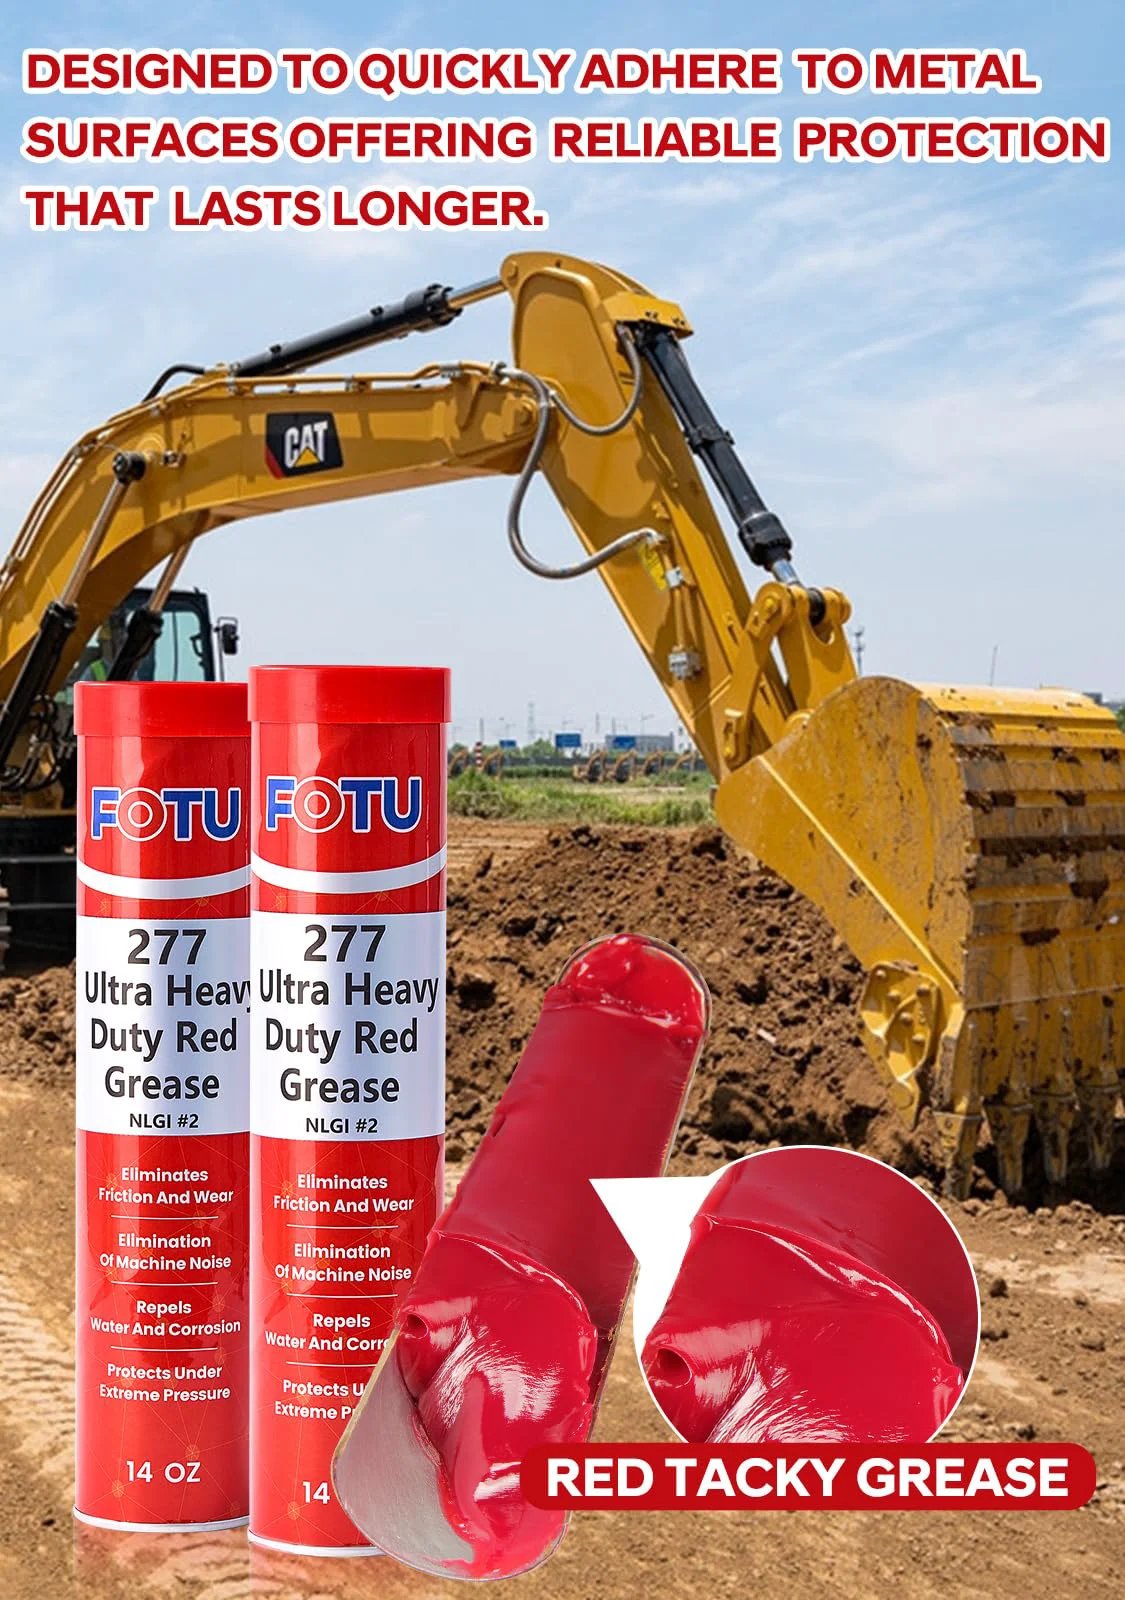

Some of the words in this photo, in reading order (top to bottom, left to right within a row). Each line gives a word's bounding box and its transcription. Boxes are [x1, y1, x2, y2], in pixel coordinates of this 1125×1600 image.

[284, 420, 328, 468] CAT
[266, 776, 421, 833] FOTU
[91, 787, 241, 842] FOTU
[127, 929, 206, 964] 277
[304, 925, 385, 962] 277
[85, 971, 151, 1005] Ultra
[259, 969, 328, 1005] Ultra
[345, 973, 438, 1012] Heavy
[91, 1018, 163, 1062] Duty
[176, 1018, 236, 1052] Red
[266, 1018, 341, 1064] Duty
[355, 1018, 417, 1054] Red
[104, 1066, 219, 1099] Grease
[280, 1069, 399, 1103] Grease
[129, 1114, 170, 1128] NLGI
[177, 1114, 198, 1128] #2
[306, 1118, 348, 1133] NLGI
[355, 1118, 377, 1133] #2
[122, 1167, 208, 1181] Eliminates
[298, 1174, 387, 1189] Eliminates
[100, 1188, 152, 1203] Friction
[157, 1191, 189, 1203] And
[194, 1191, 233, 1203] Wear
[275, 1196, 329, 1212] Friction
[334, 1199, 368, 1212] And
[373, 1199, 414, 1211] Wear
[119, 1233, 210, 1248] Elimination
[295, 1243, 390, 1258] Elimination
[100, 1254, 116, 1267] Of
[116, 1256, 186, 1269] Machine
[190, 1255, 230, 1269] Noise
[275, 1265, 290, 1279] Of
[291, 1267, 364, 1281] Machine
[369, 1266, 411, 1281] Noise
[137, 1301, 191, 1317] Repels
[91, 1318, 129, 1334] Water
[132, 1323, 164, 1335] And
[169, 1320, 240, 1335] Corrosion
[314, 1314, 370, 1331] Repels
[266, 1331, 306, 1348] Water
[309, 1337, 342, 1350] And
[108, 1364, 170, 1379] Protects
[175, 1366, 222, 1379] Under
[100, 1384, 159, 1401] Extreme
[164, 1389, 230, 1401] Pressure
[284, 1380, 348, 1396] Protects
[276, 1401, 337, 1419] Extreme
[127, 1461, 152, 1482] 14
[165, 1462, 200, 1482] OZ
[303, 1482, 330, 1503] 14
